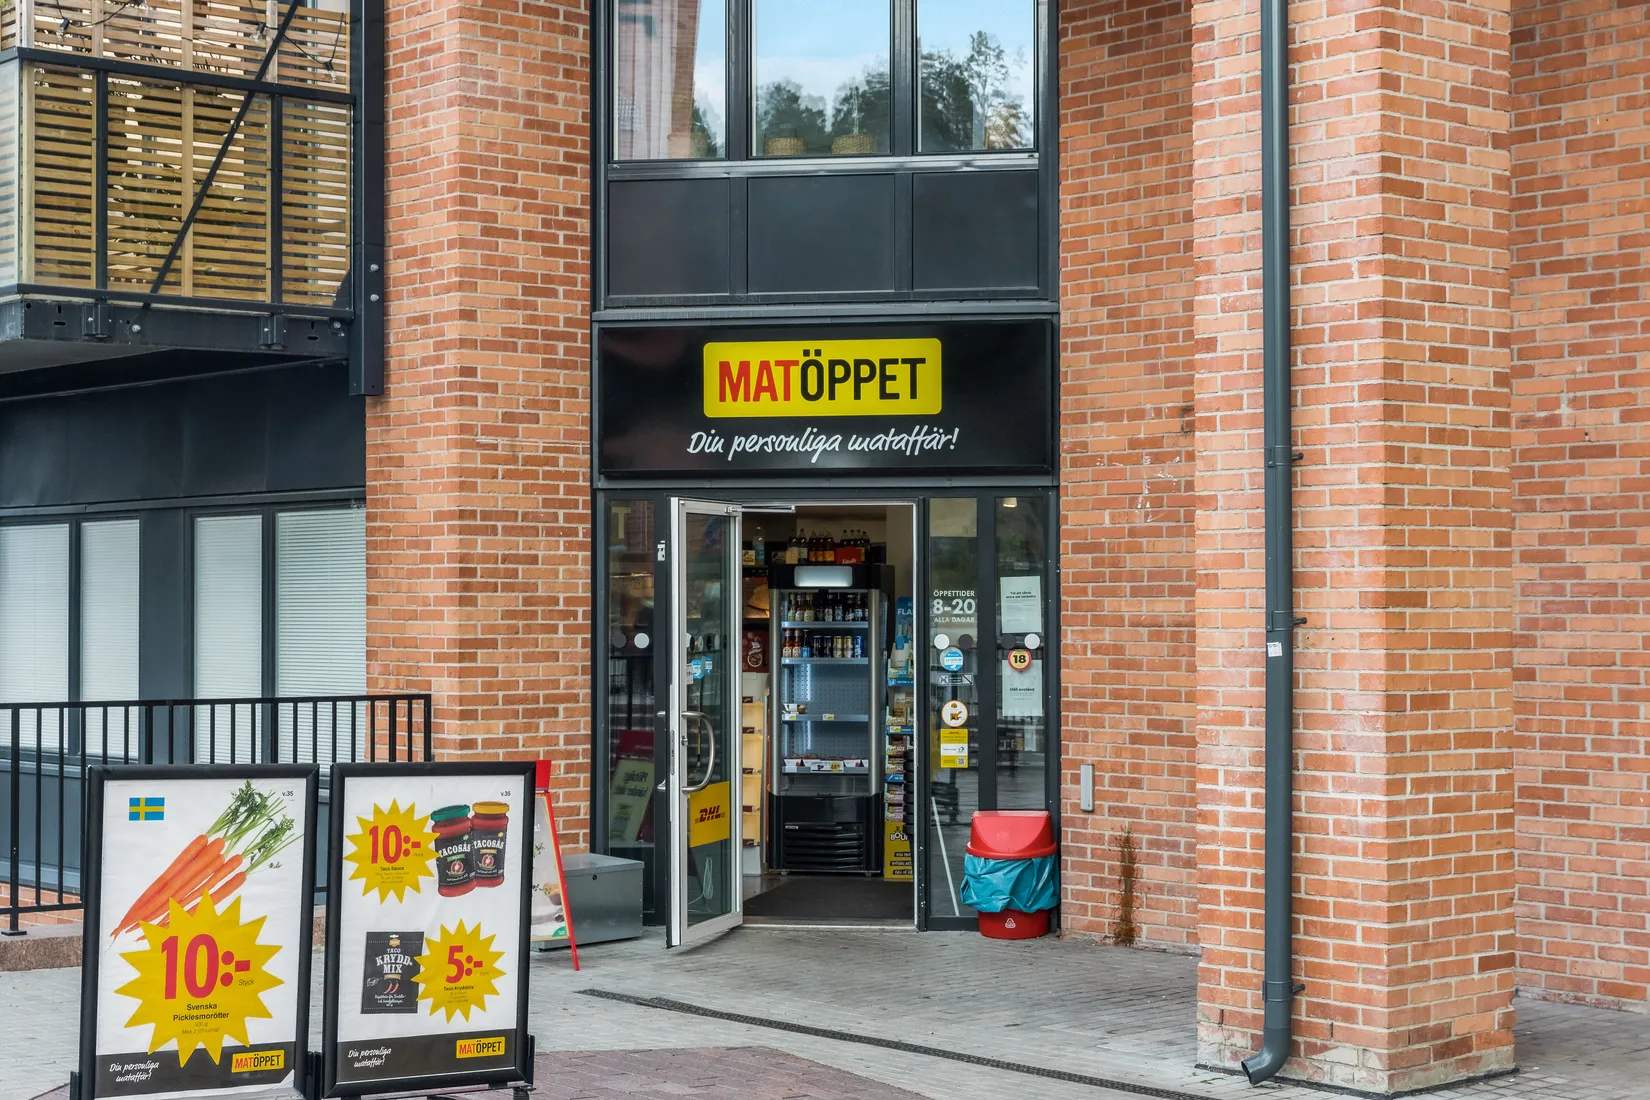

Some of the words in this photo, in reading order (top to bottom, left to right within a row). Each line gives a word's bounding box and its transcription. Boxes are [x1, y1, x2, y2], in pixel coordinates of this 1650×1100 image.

[719, 349, 926, 402] MATÖPPET
[687, 429, 724, 454] Din
[728, 427, 840, 463] personliga
[847, 425, 959, 456] mataffär!
[933, 589, 975, 597] ÖPPETTIDER
[933, 598, 976, 614] 8-20
[1013, 654, 1026, 664] 18
[281, 790, 294, 798] v.35
[699, 805, 722, 822] DHL
[369, 824, 421, 864] 10:-
[438, 841, 471, 858] TACOSÅS
[473, 838, 504, 850] TACOSÅS
[161, 933, 250, 1000] 10:-
[375, 953, 413, 966] KRYDD-
[445, 945, 483, 984] 5:-
[383, 964, 403, 973] MIX
[238, 979, 254, 987] Styck
[187, 1003, 217, 1011] Svenska
[173, 1012, 230, 1021] Picklesmorötter
[348, 1049, 358, 1058] Din
[359, 1046, 392, 1060] personliga
[459, 1039, 503, 1056] MATÖPPET
[109, 1062, 122, 1072] Din
[122, 1060, 160, 1074] personliga
[234, 1053, 281, 1069] MATÖPPET
[354, 1056, 386, 1069] mataffär!
[115, 1070, 152, 1083] mataffär!
